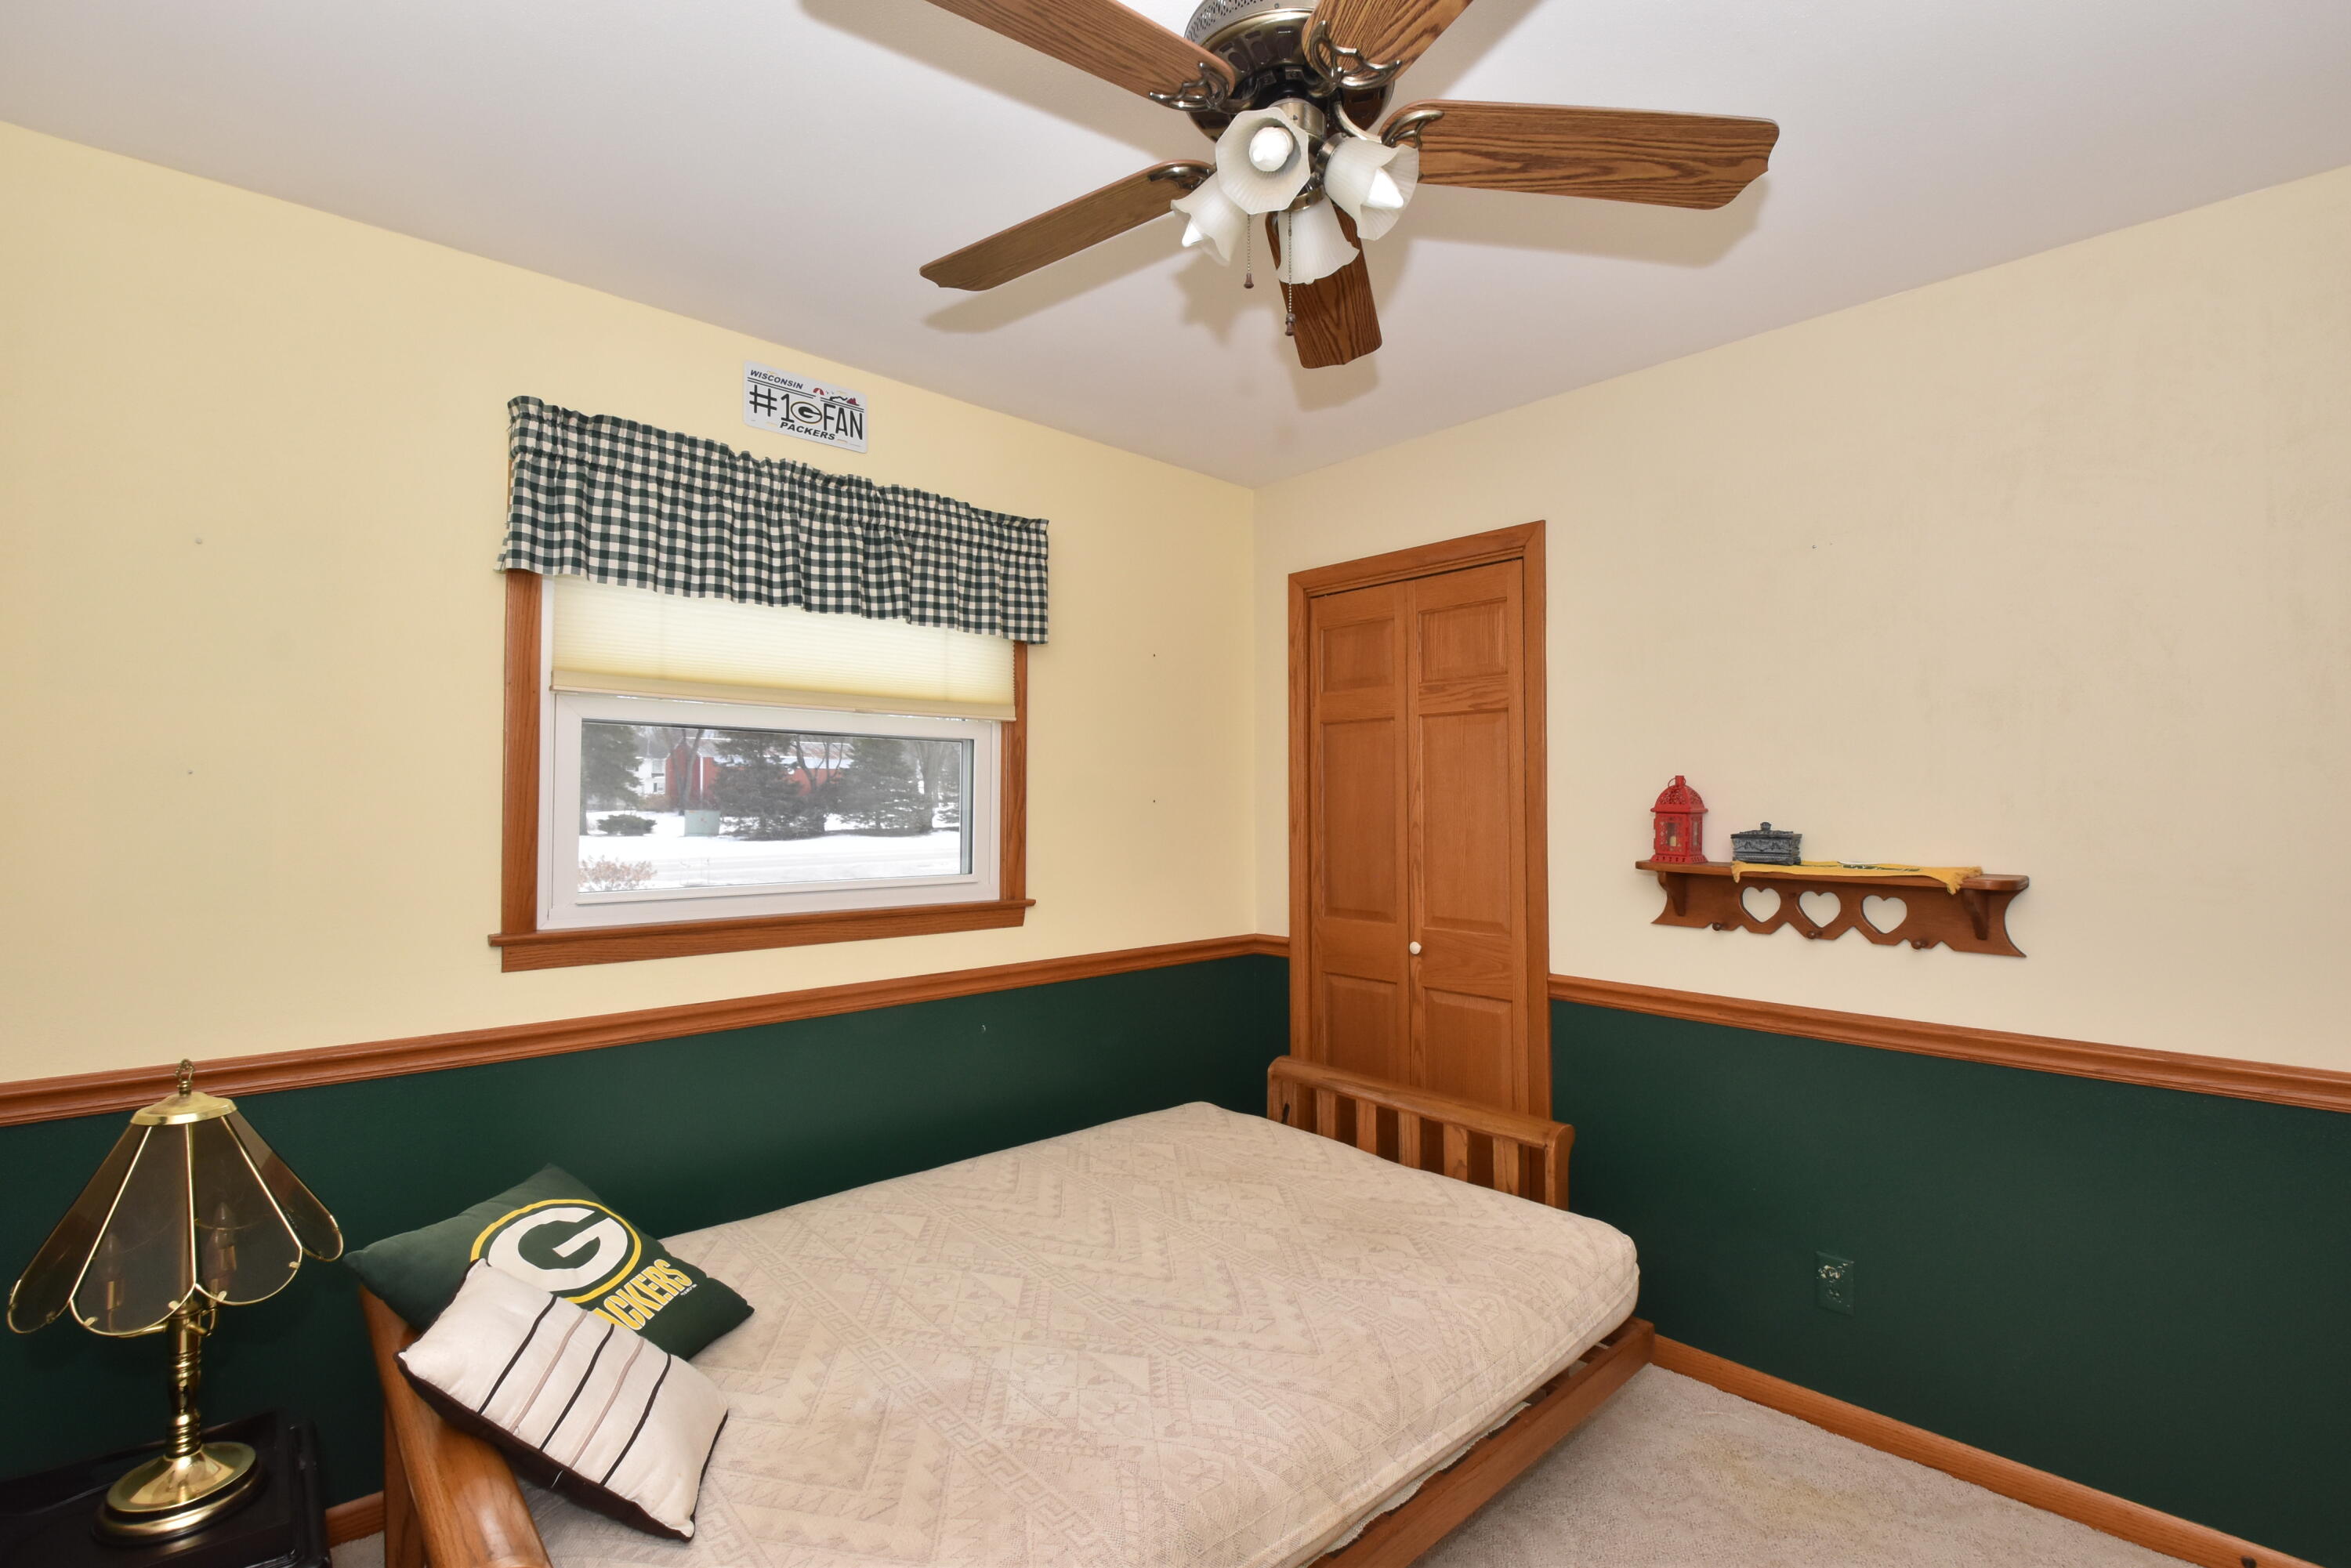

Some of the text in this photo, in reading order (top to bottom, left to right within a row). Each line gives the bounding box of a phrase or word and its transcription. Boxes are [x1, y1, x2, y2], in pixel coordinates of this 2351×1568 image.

[750, 369, 804, 389] WISCONSIN
[748, 384, 795, 423] #1
[824, 403, 863, 440] FAN
[780, 422, 835, 440] PACKERS
[487, 1207, 628, 1292] G
[593, 1258, 693, 1331] CKERS
